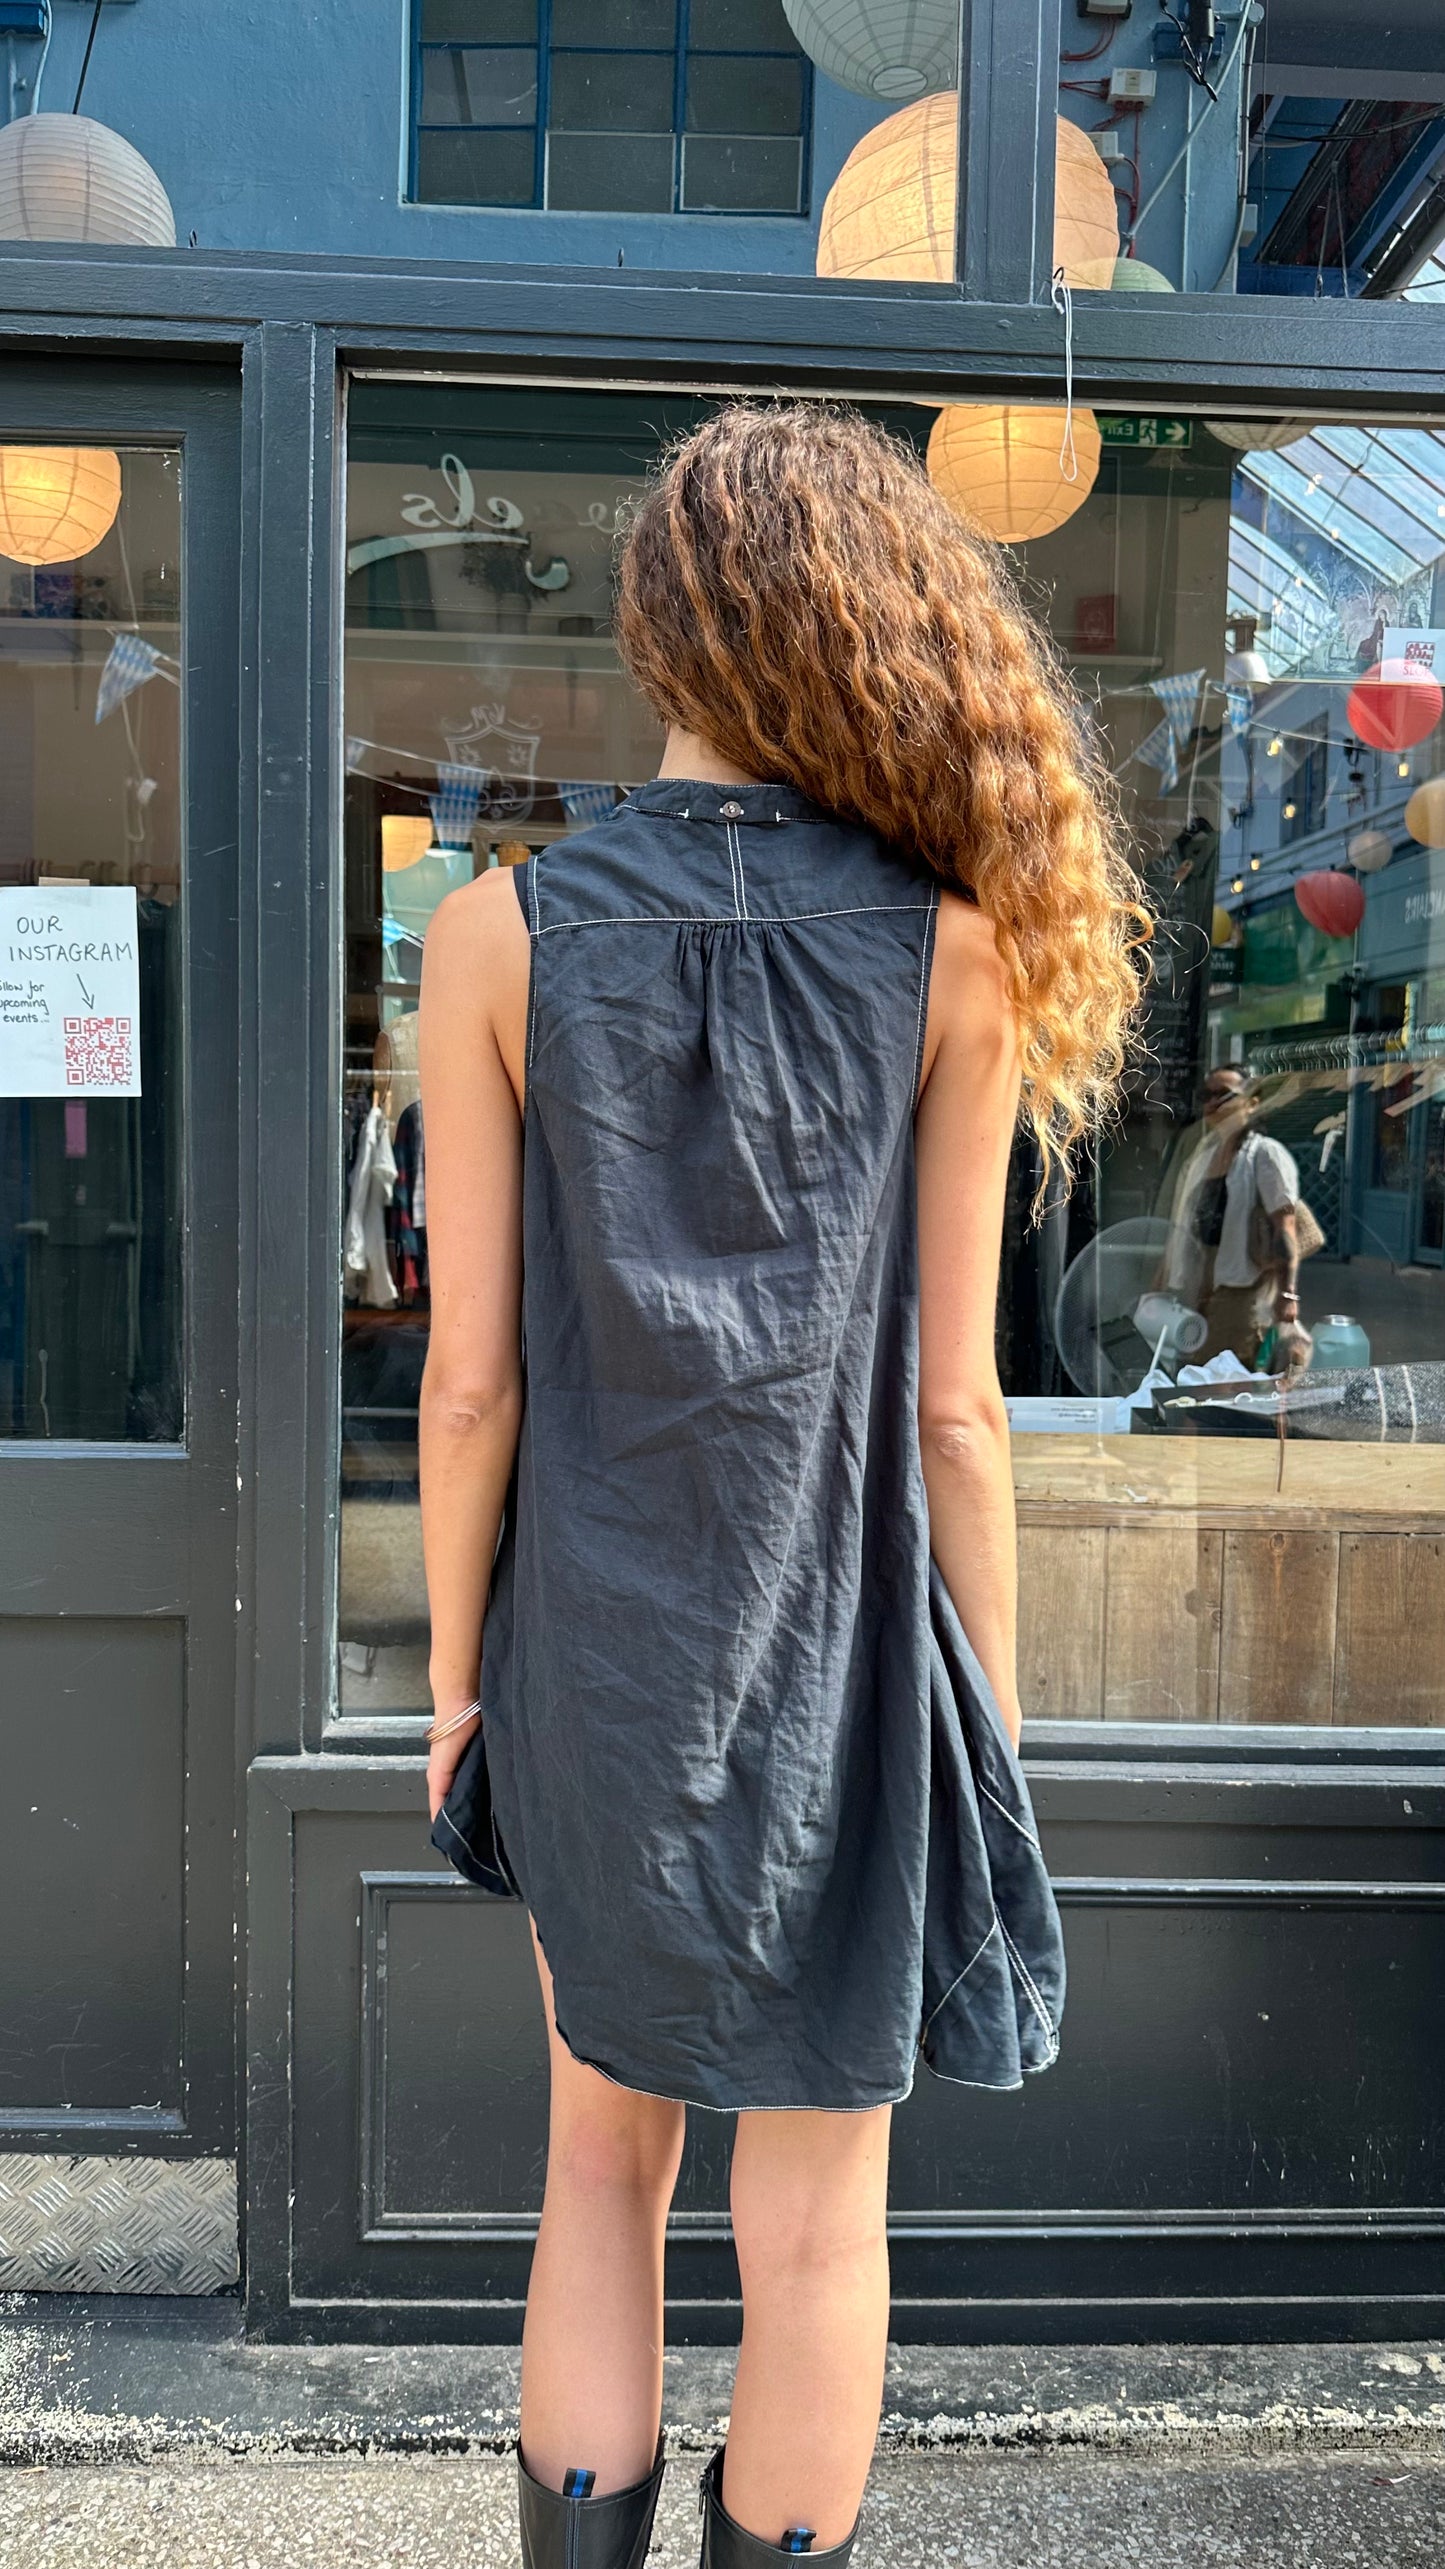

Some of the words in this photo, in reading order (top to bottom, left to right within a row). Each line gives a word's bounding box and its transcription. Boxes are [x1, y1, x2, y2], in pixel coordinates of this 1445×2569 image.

[16, 915, 63, 934] OUR
[9, 942, 132, 962] INSTAGRAM
[27, 979, 46, 1000] for
